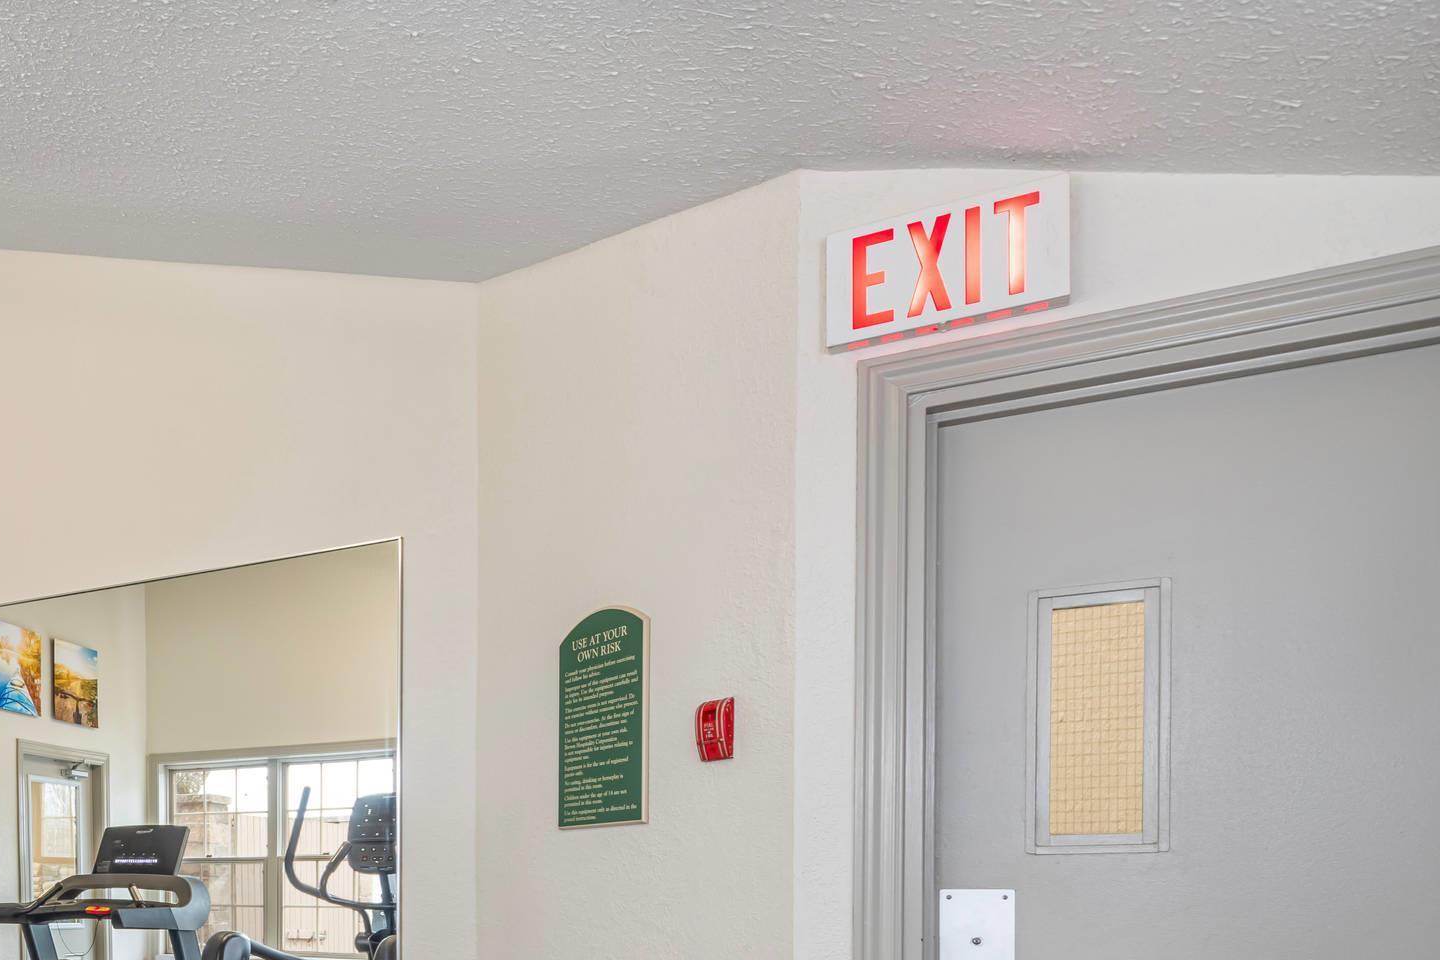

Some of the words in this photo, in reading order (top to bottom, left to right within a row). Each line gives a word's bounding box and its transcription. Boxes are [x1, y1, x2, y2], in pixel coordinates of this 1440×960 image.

[851, 190, 1040, 330] EXIT
[572, 637, 588, 651] USE
[589, 633, 602, 646] AT
[602, 625, 628, 642] YOUR
[577, 647, 599, 662] OWN
[600, 640, 622, 656] RISK
